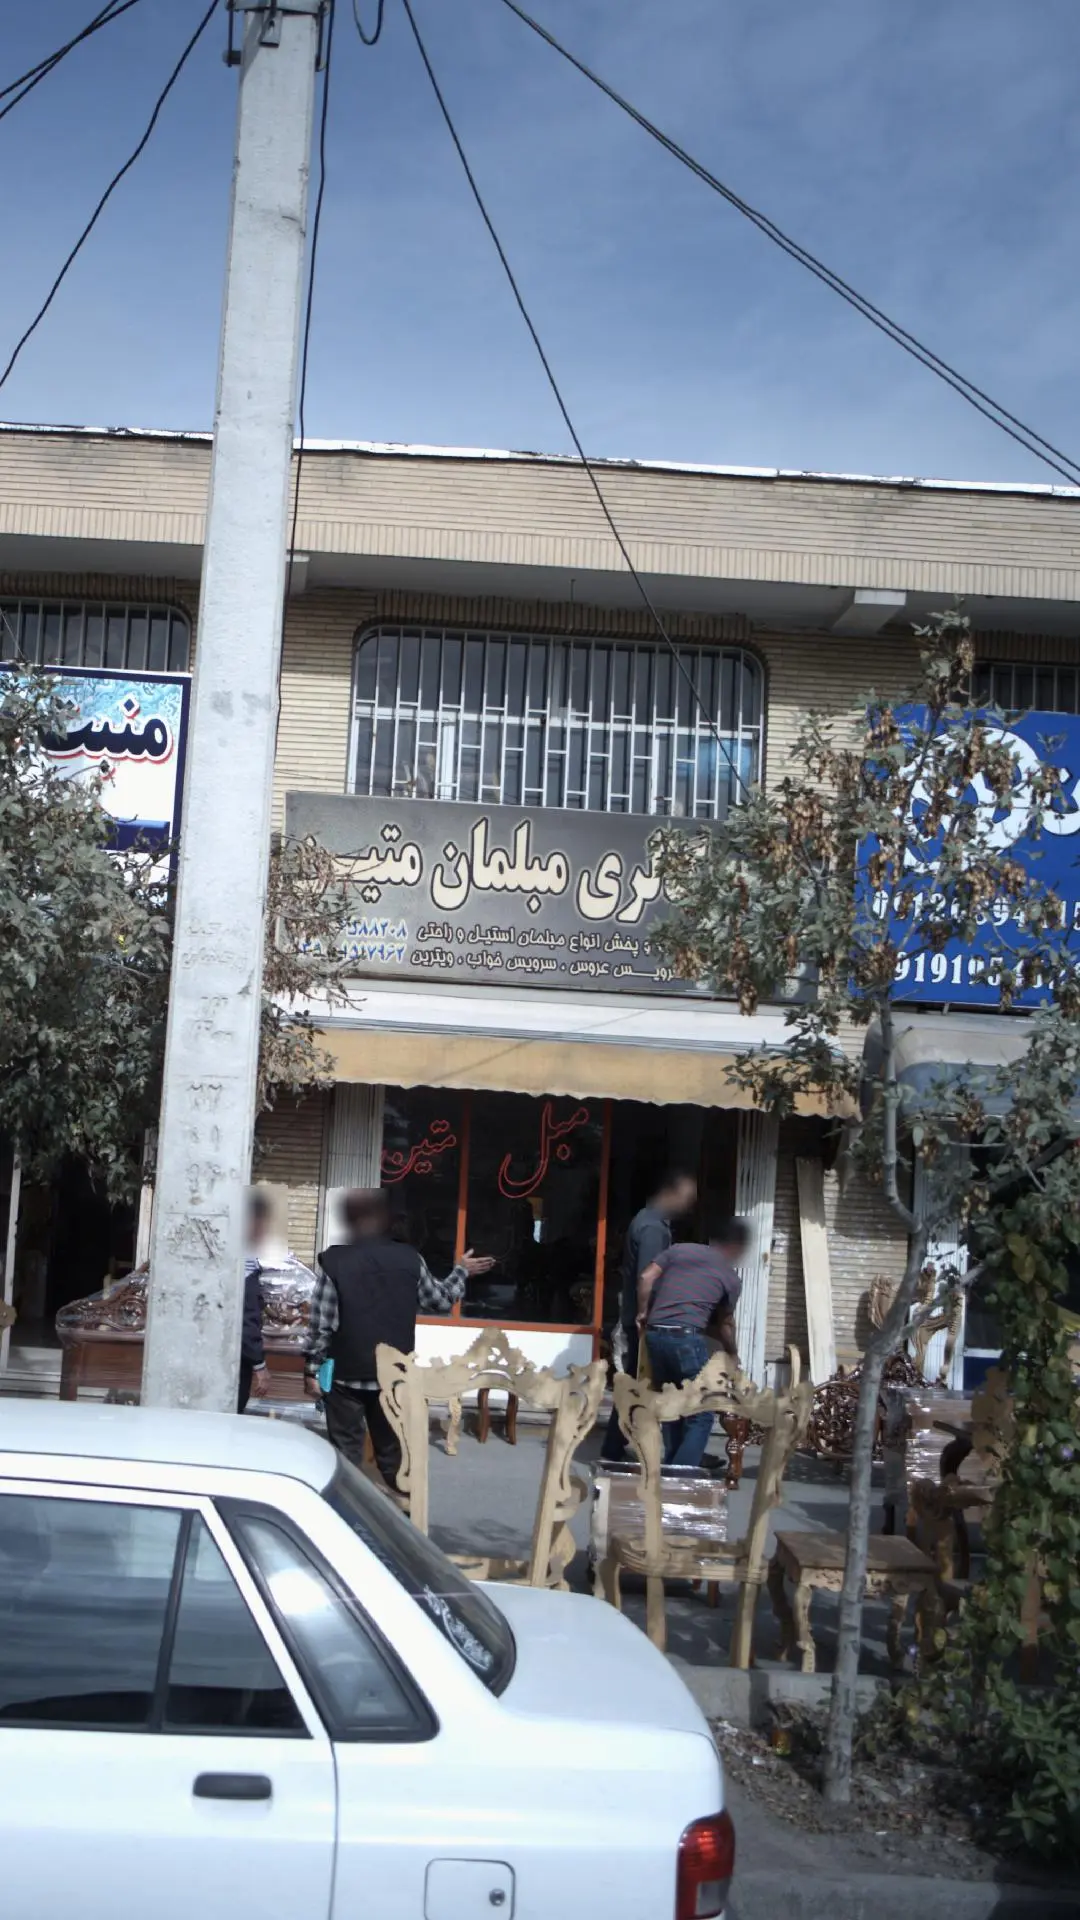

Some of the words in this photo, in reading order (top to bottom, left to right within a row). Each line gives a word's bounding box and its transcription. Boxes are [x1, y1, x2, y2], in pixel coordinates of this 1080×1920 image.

[430, 817, 570, 914] مبلمان
[417, 922, 453, 943] راحتی
[456, 928, 465, 943] و
[467, 924, 515, 945] استیل
[517, 928, 565, 950] مبلمان
[569, 932, 600, 952] انواع
[604, 932, 639, 957] پخش
[411, 948, 454, 967] ویترین
[466, 951, 502, 970] خواب
[506, 956, 557, 973] سرویس
[570, 960, 609, 977] عروس
[498, 1101, 589, 1198] مبل
